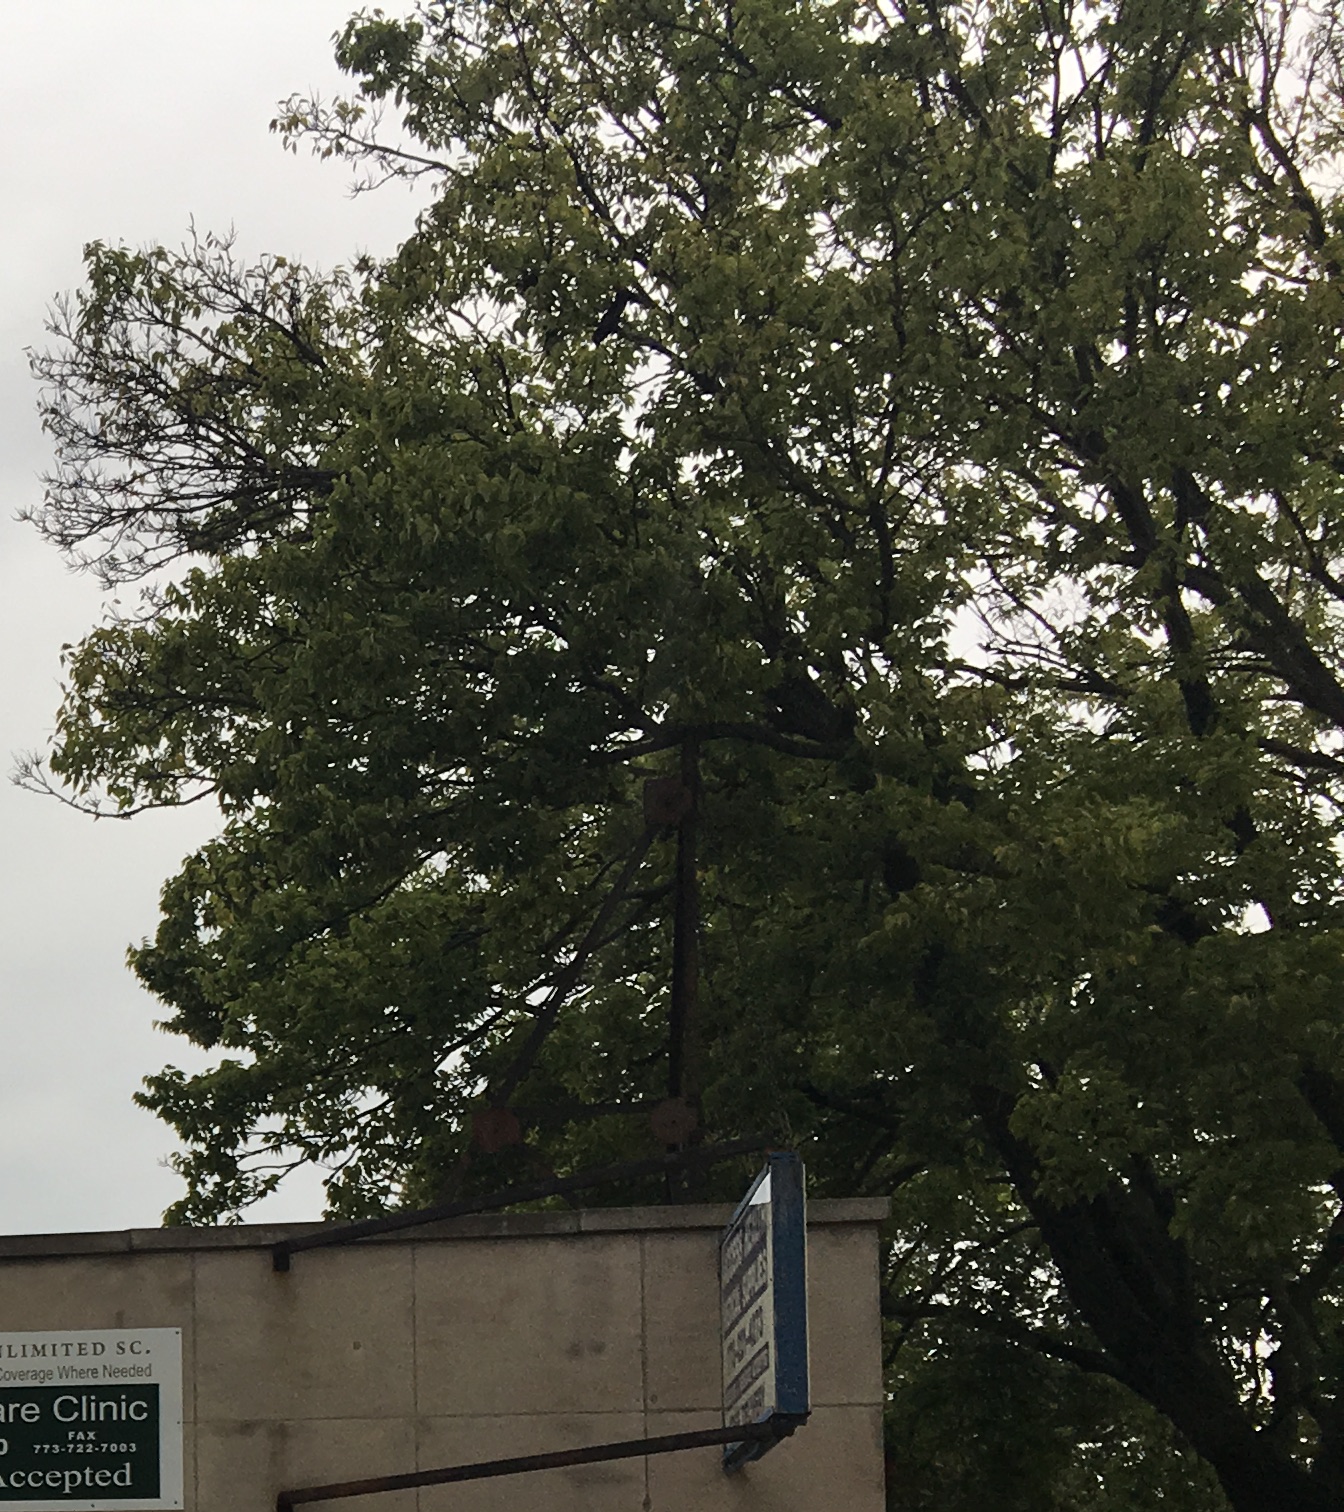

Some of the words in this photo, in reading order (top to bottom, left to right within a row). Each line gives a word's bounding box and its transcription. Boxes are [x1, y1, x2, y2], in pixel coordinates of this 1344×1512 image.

[115, 1340, 151, 1356] SC.
[57, 1364, 99, 1380] Where
[102, 1363, 152, 1379] Needed
[53, 1395, 148, 1424] Clinic
[67, 1431, 96, 1441] FAX
